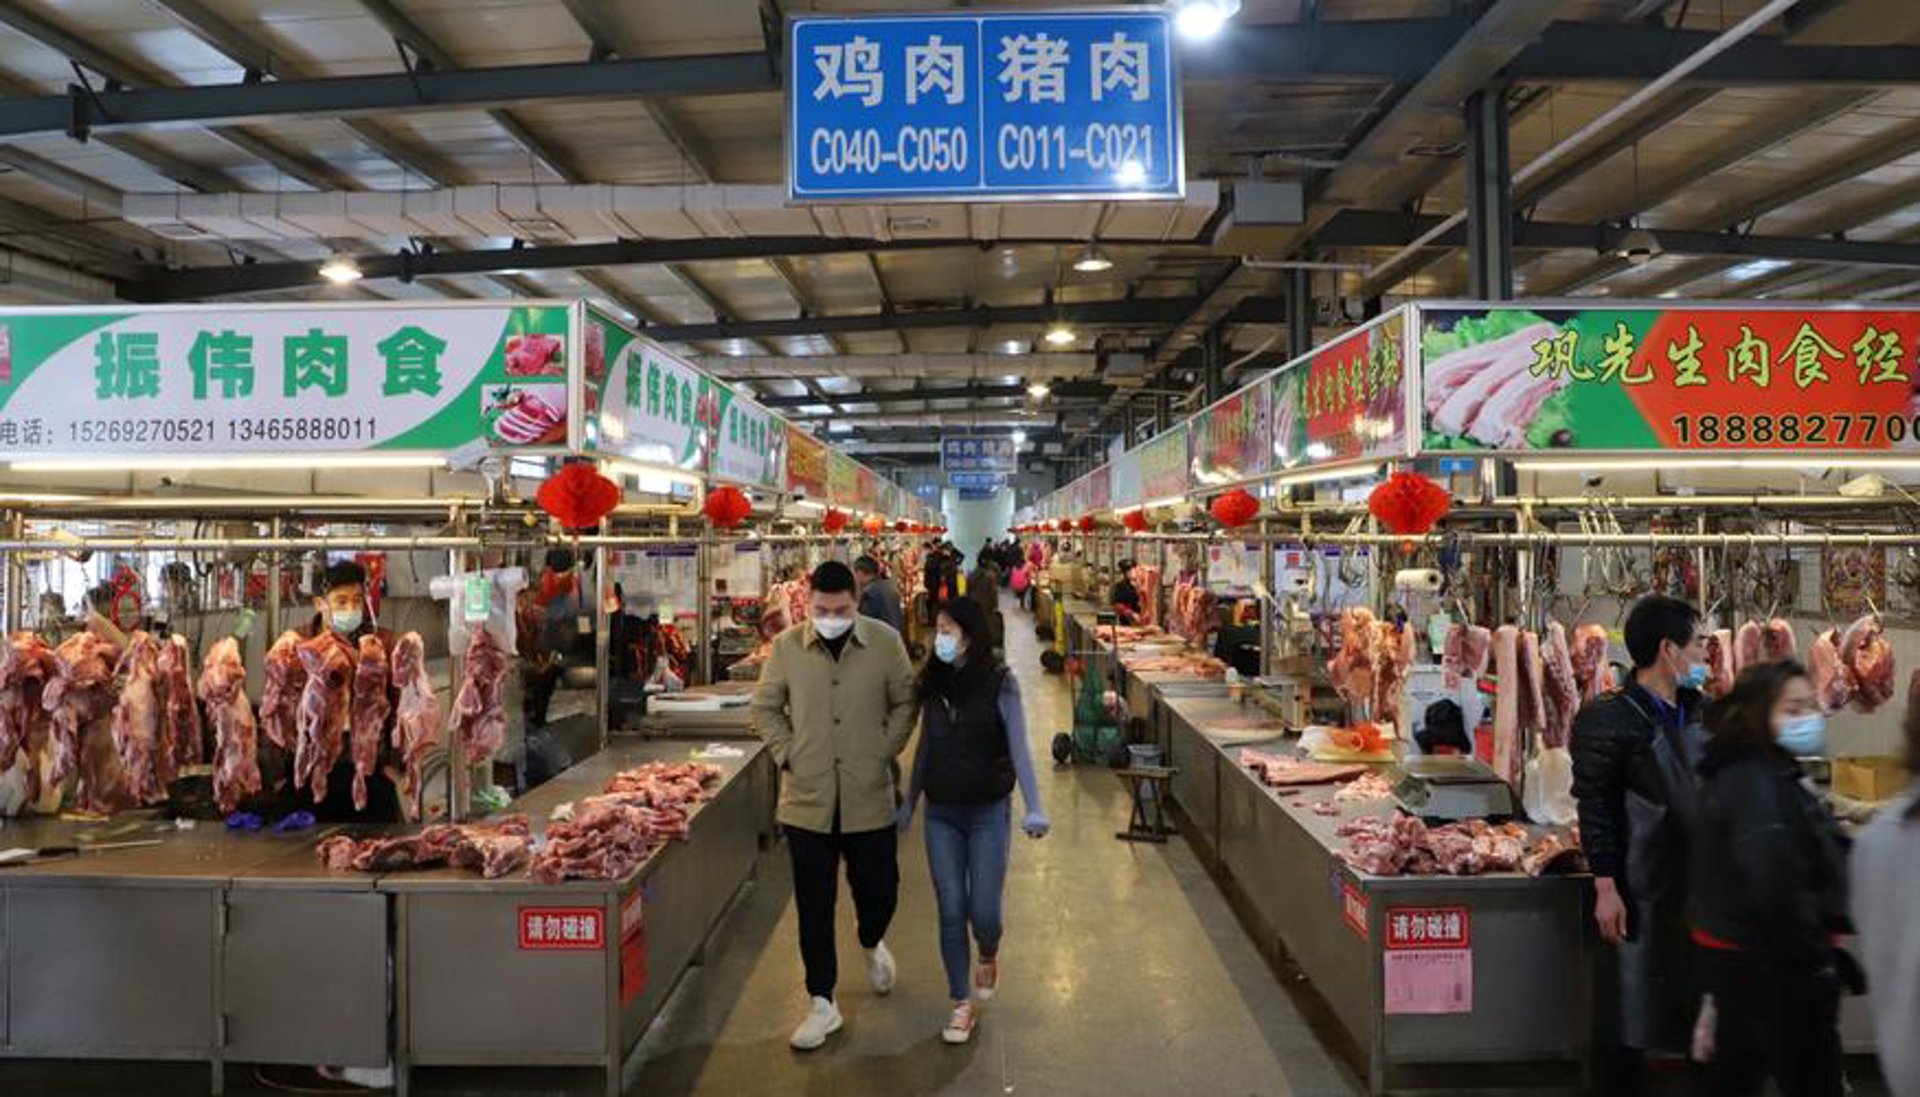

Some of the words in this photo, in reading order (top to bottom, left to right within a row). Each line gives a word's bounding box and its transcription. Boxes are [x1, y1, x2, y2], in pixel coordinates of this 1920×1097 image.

[813, 35, 966, 107] 鸡肉
[998, 32, 1150, 104] 猪肉
[811, 126, 967, 174] C040-C050
[999, 122, 1153, 171] C011-C021
[94, 325, 447, 400] 振伟肉食
[1529, 321, 1910, 388] 巩先生肉食经
[69, 419, 215, 442] 15269270521
[227, 417, 377, 441] 13465888011
[527, 914, 597, 940] 请勿碰撞
[1392, 912, 1461, 940] 请勿碰撞
